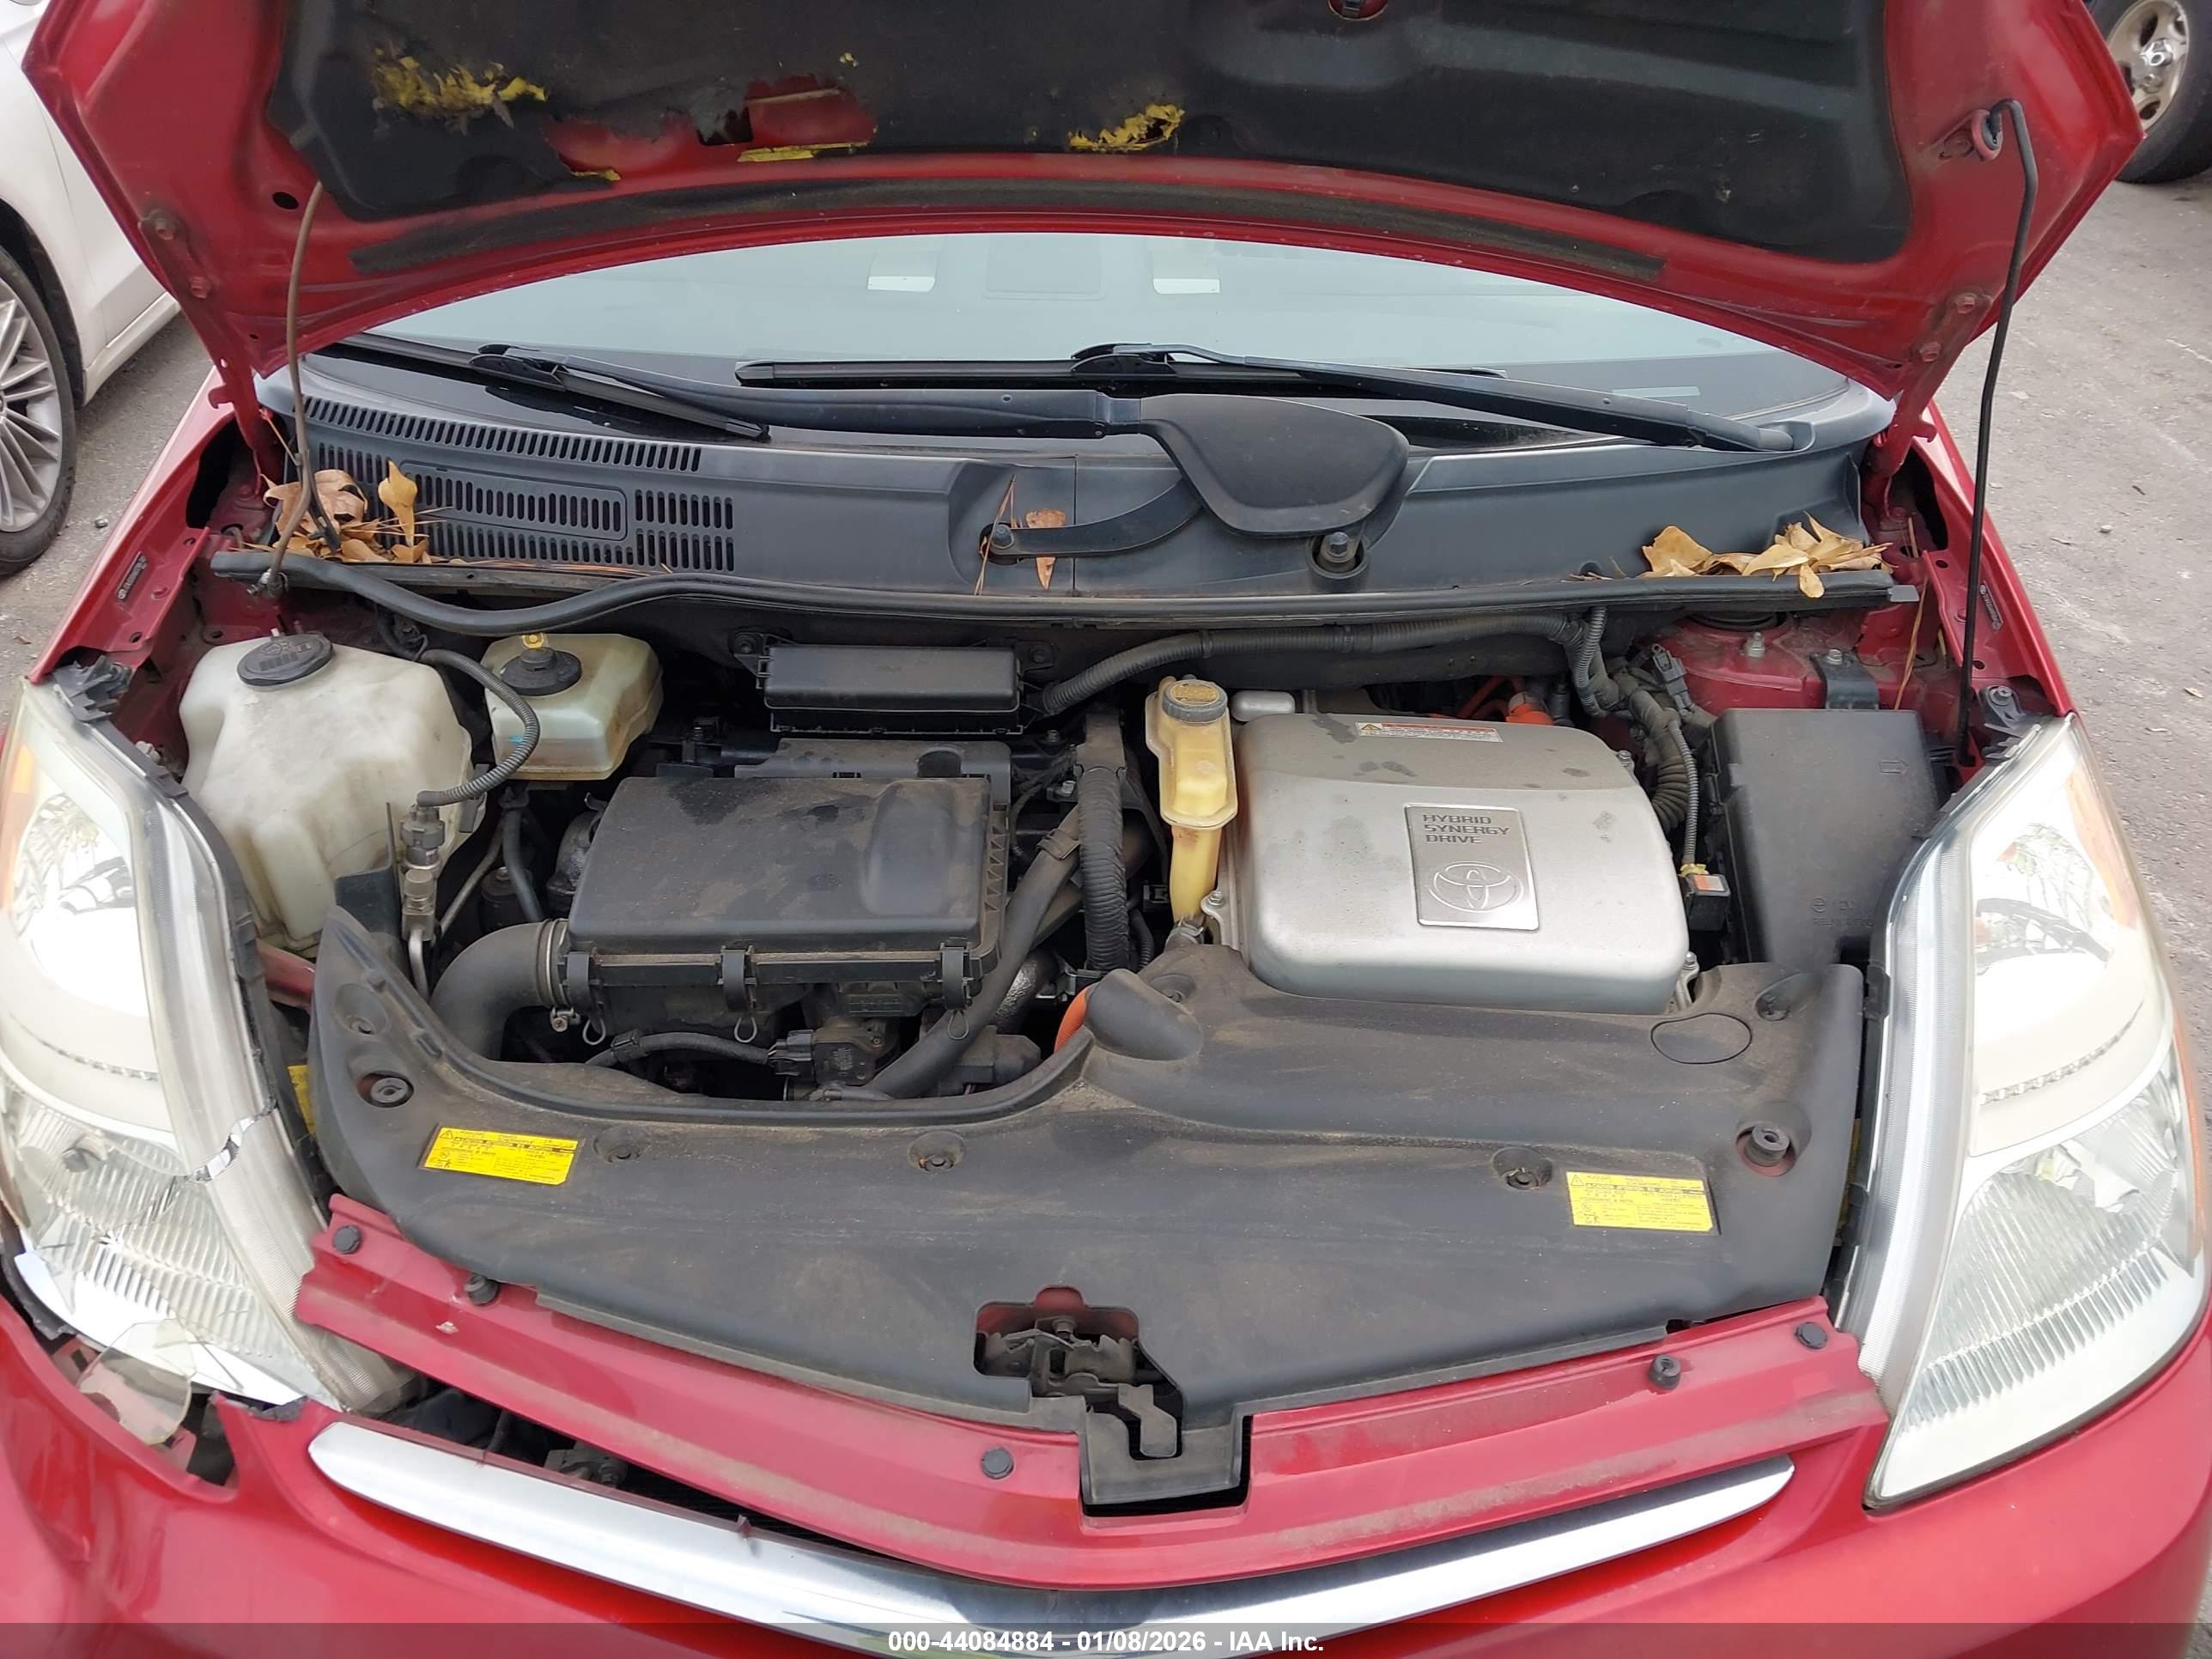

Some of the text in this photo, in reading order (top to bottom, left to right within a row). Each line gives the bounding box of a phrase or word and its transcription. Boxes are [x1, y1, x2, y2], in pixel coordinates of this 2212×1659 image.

[1423, 814, 1492, 824] HYBRID
[1424, 824, 1510, 836] SYNERGY
[1425, 834, 1484, 844] DRIVE
